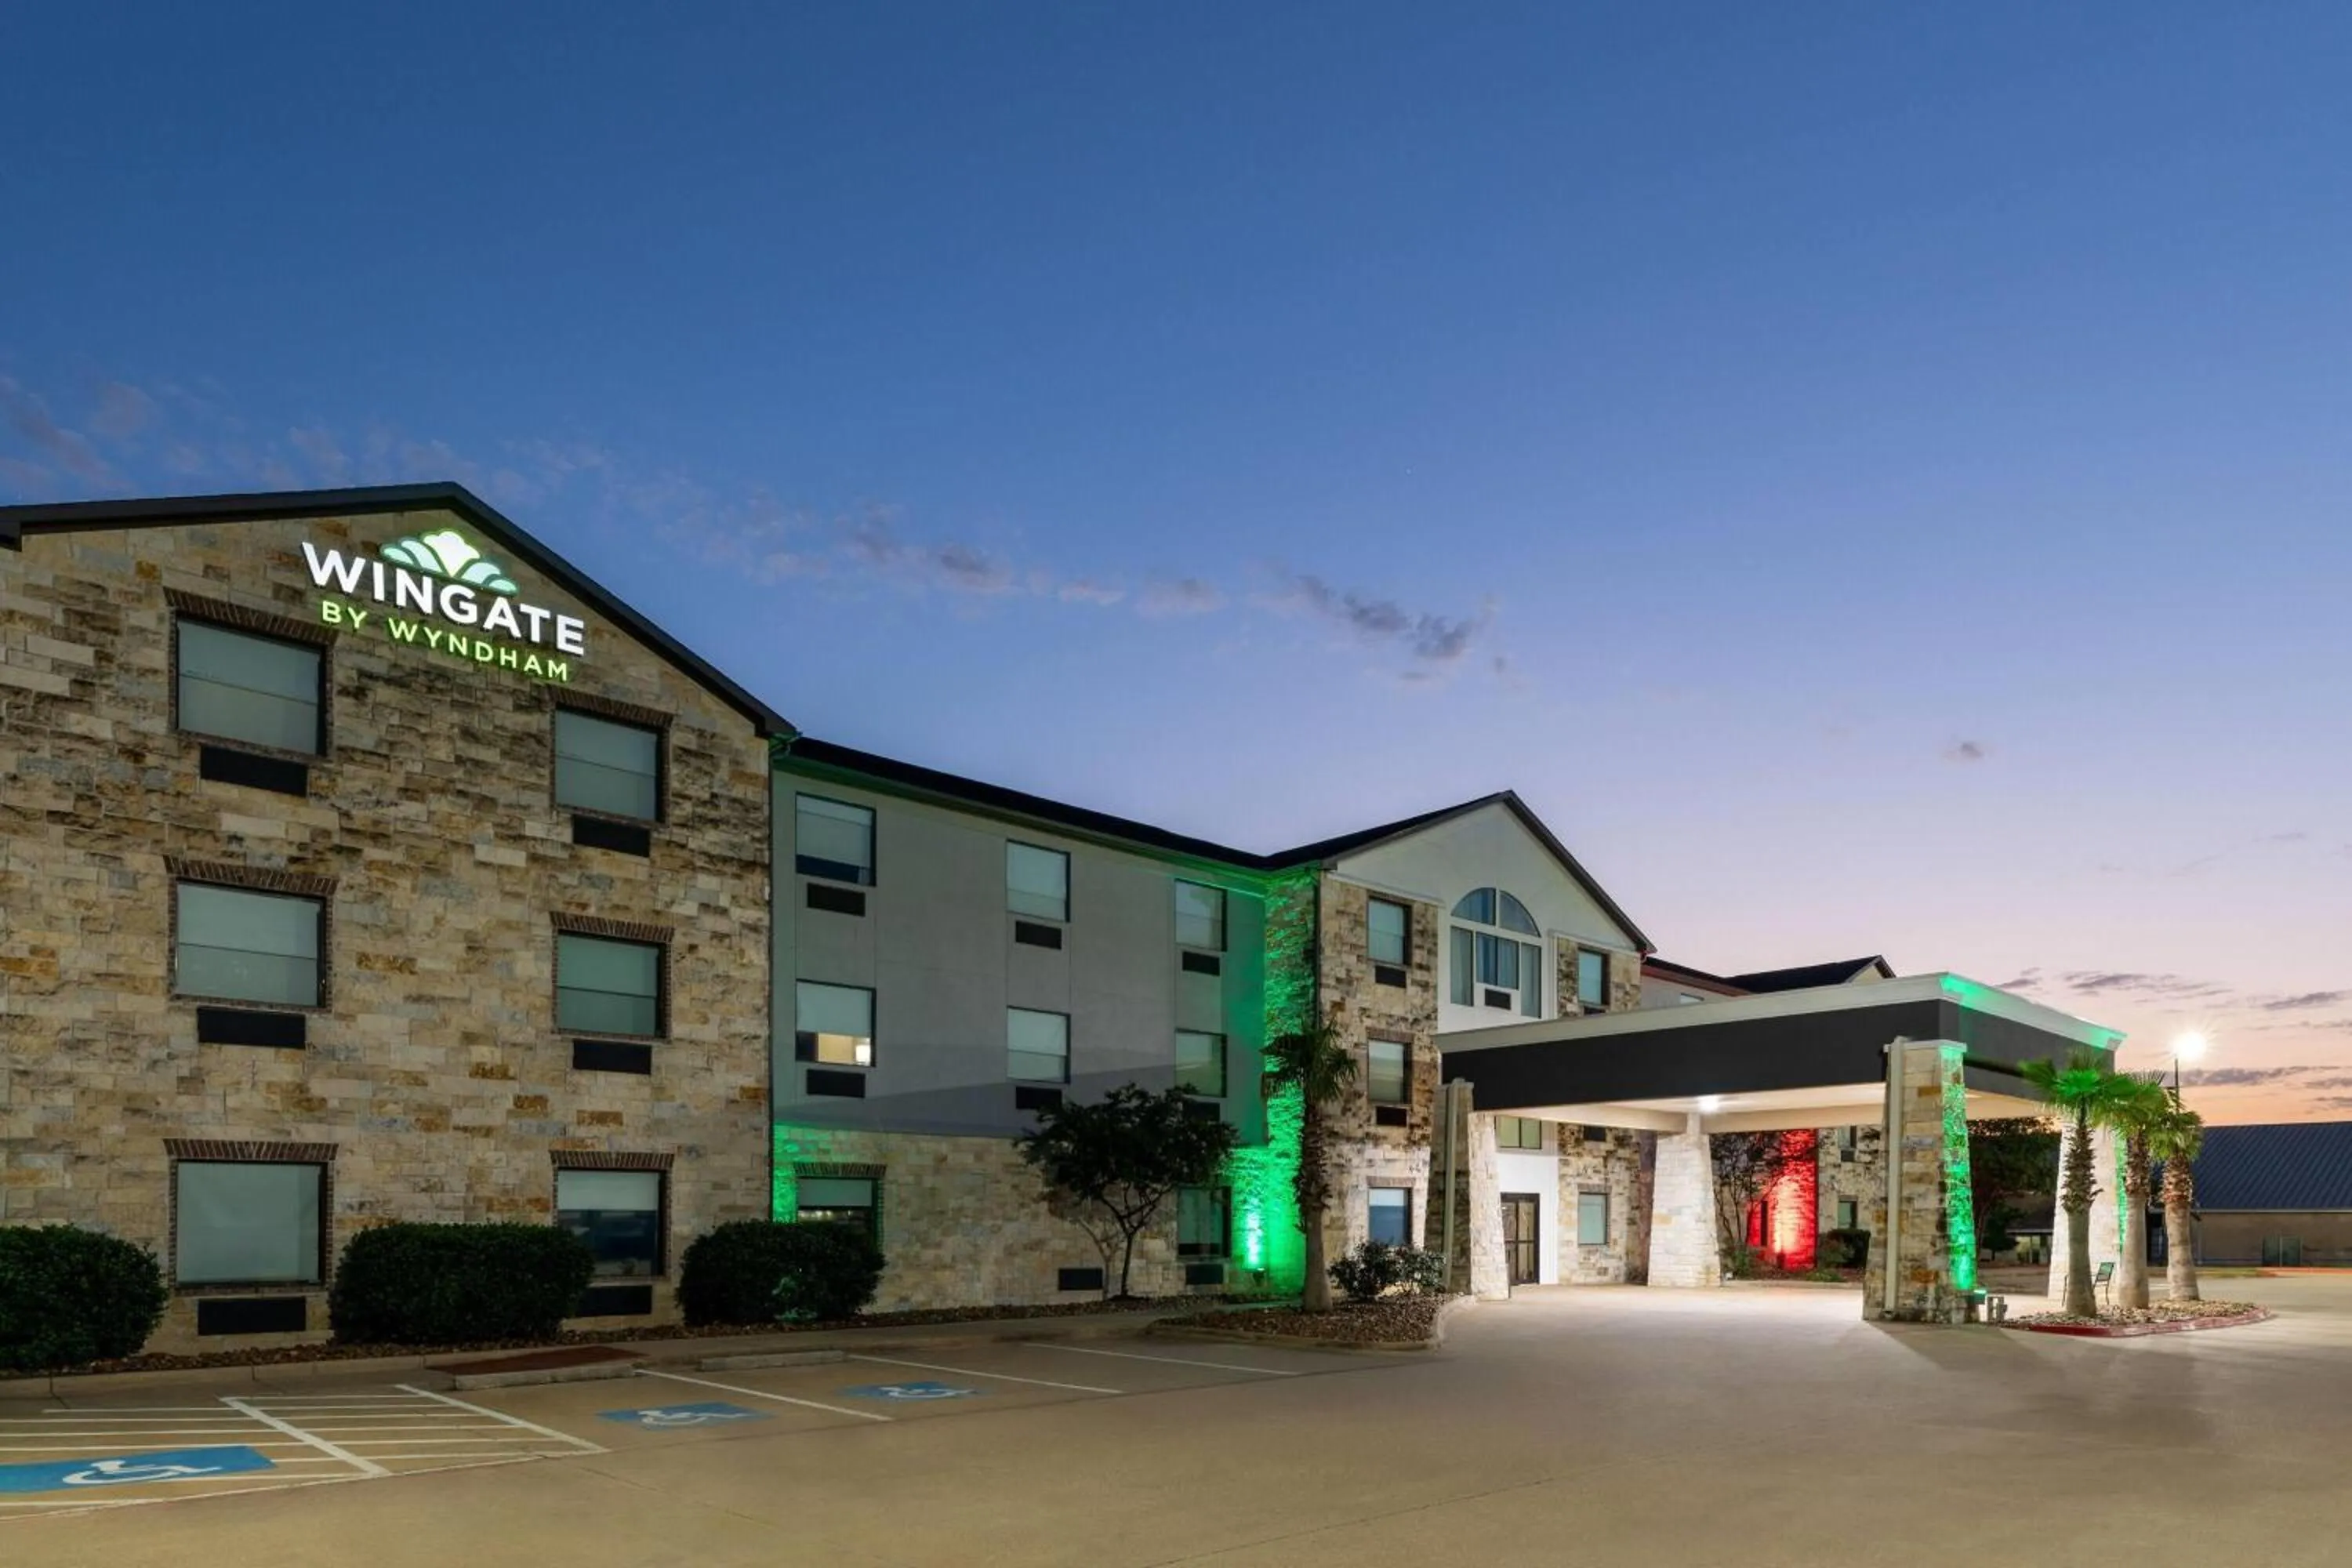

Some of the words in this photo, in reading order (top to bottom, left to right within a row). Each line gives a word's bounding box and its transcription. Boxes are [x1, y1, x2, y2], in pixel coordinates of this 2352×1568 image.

[302, 541, 585, 656] WINGATE
[321, 600, 368, 630] BY
[388, 616, 568, 681] WYNDHAM
